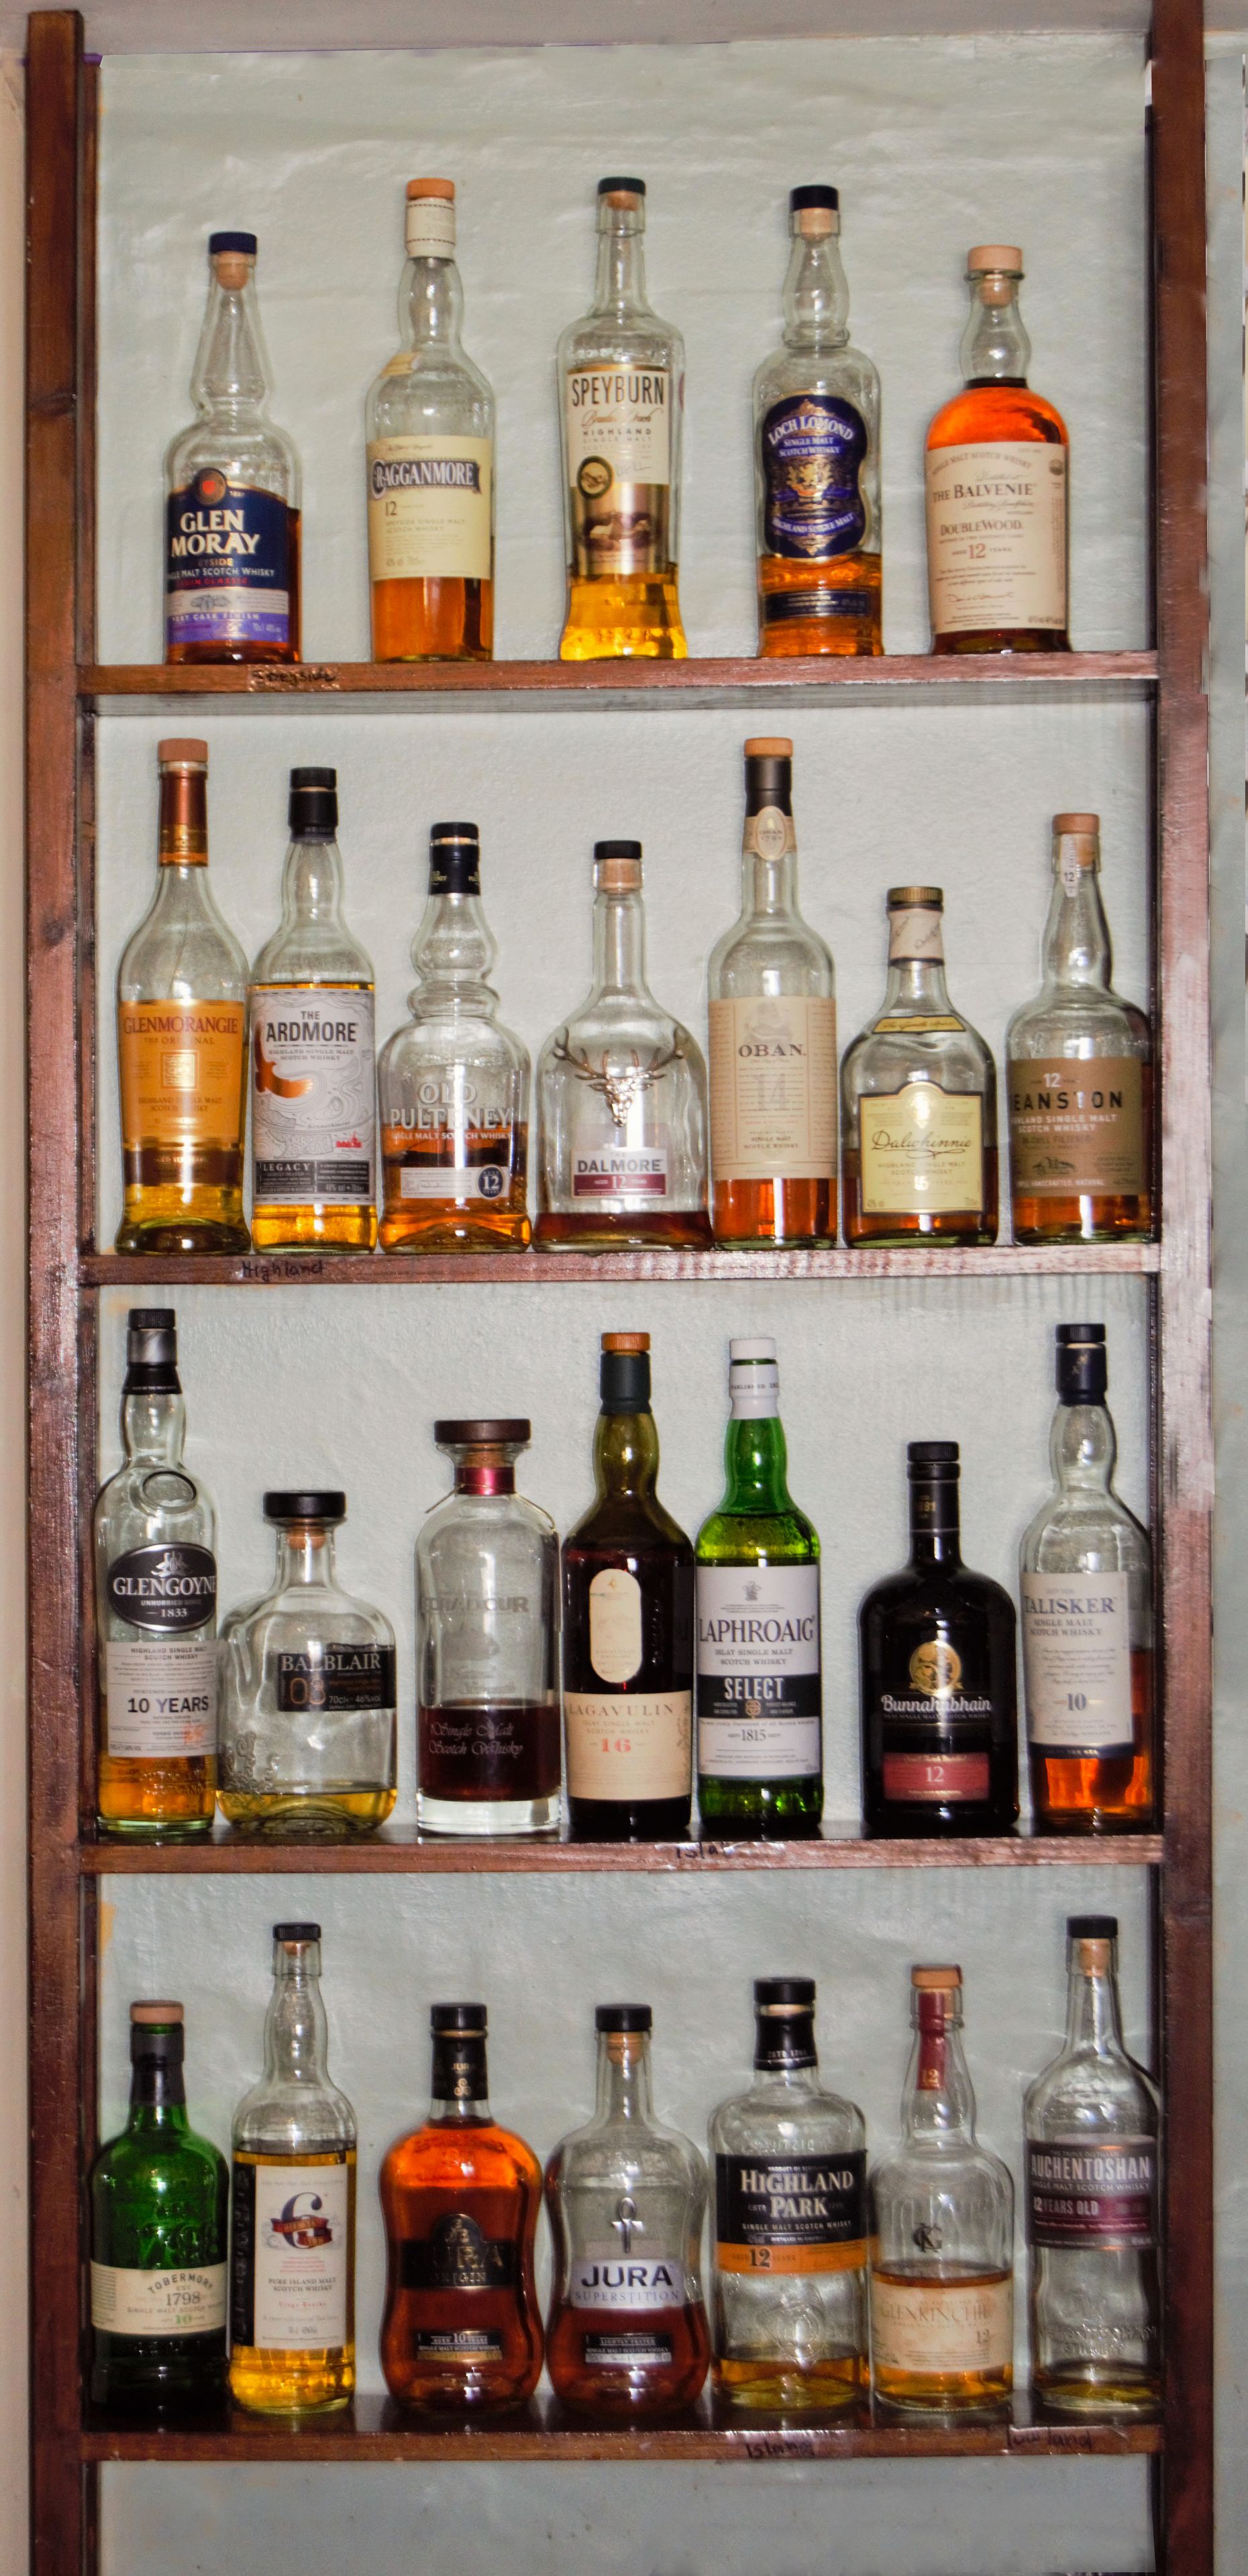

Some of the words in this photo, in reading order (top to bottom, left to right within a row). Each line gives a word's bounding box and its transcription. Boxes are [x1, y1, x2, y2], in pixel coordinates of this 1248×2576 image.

[572, 375, 664, 407] SPEYBURN
[582, 429, 652, 437] HIGHLAND
[768, 419, 798, 445] LOCH
[800, 415, 854, 441] LOMOND
[783, 437, 811, 447] SINGLE
[813, 437, 835, 445] MALT
[779, 446, 807, 457] SCOTCH
[809, 446, 841, 455] WHISKY
[933, 490, 951, 504] THE
[953, 482, 1033, 500] BALVENIE
[385, 501, 398, 516] 12
[180, 509, 244, 533] GLEN
[836, 512, 854, 528] MALT
[171, 532, 260, 557] MORAY
[968, 543, 987, 558] 12
[181, 569, 200, 578] MALT
[203, 568, 239, 576] SCOTCH
[242, 567, 275, 577] WHISKY
[204, 575, 248, 584] CLASSIC
[193, 612, 218, 621] CASK
[1063, 871, 1075, 882] 12
[300, 1011, 321, 1021] THE
[124, 1016, 239, 1034] GLENMORANGIE
[266, 1022, 357, 1043] ARDMORE
[1043, 1073, 1061, 1087] 12
[419, 1081, 478, 1106] OLD
[1012, 1091, 1123, 1111] EANSTON
[389, 1107, 513, 1130] PULTENEY
[1045, 1114, 1085, 1124] SINGLE
[1090, 1114, 1118, 1122] MALT
[415, 1132, 440, 1140] MALT
[480, 1132, 513, 1140] WHISKY
[1018, 1125, 1050, 1134] SCOTCH
[1053, 1124, 1096, 1132] WHISKY
[871, 1130, 972, 1151] Dalwhinnie
[263, 1164, 311, 1175] LEGACY
[578, 1159, 664, 1173] DALMORE
[482, 1176, 500, 1190] 12
[611, 1175, 627, 1189] 12
[242, 1259, 323, 1283] Highland
[1023, 1596, 1115, 1614] TALISKER
[160, 1608, 188, 1618] 1833
[699, 1617, 814, 1643] LAPHROAIG
[1034, 1619, 1063, 1627] SINGLE
[1065, 1618, 1094, 1626] MALT
[1030, 1628, 1059, 1636] SCOTCH
[1062, 1627, 1102, 1636] WHISKY
[281, 1652, 382, 1672] BALBLAIR
[720, 1658, 750, 1666] SCOTCH
[753, 1657, 786, 1665] WHISKY
[724, 1677, 784, 1700] SELECT
[127, 1697, 150, 1713] 10
[156, 1695, 209, 1713] YEARS
[881, 1694, 992, 1713] Bunnahabhain
[1068, 1692, 1088, 1711] 10
[568, 1703, 673, 1717] LAGAVULIN
[431, 1722, 472, 1741] Single
[741, 1729, 766, 1742] 1815
[428, 1739, 467, 1755] Scotch
[472, 1739, 523, 1758] Whisky
[601, 1738, 631, 1753] 16
[925, 1766, 945, 1782] 12
[1031, 2153, 1151, 2182] AUCHENTOSHAN
[740, 2170, 854, 2194] HIGHLAND
[1055, 2182, 1074, 2190] MALT
[1076, 2184, 1113, 2192] SCOTCH
[1116, 2182, 1150, 2191] WHISKY
[770, 2196, 829, 2218] PARK
[1043, 2198, 1074, 2215] YEARS
[1076, 2200, 1100, 2216] OLD
[827, 2220, 852, 2229] WHISKY
[749, 2248, 771, 2268] 12
[147, 2272, 213, 2294] TOBERMORY
[580, 2265, 674, 2288] JURA
[305, 2284, 333, 2292] WHISKY
[166, 2291, 201, 2306] 1798
[574, 2290, 680, 2304] SUPERSTITION
[454, 2332, 467, 2343] 10
[976, 2328, 990, 2344] 12
